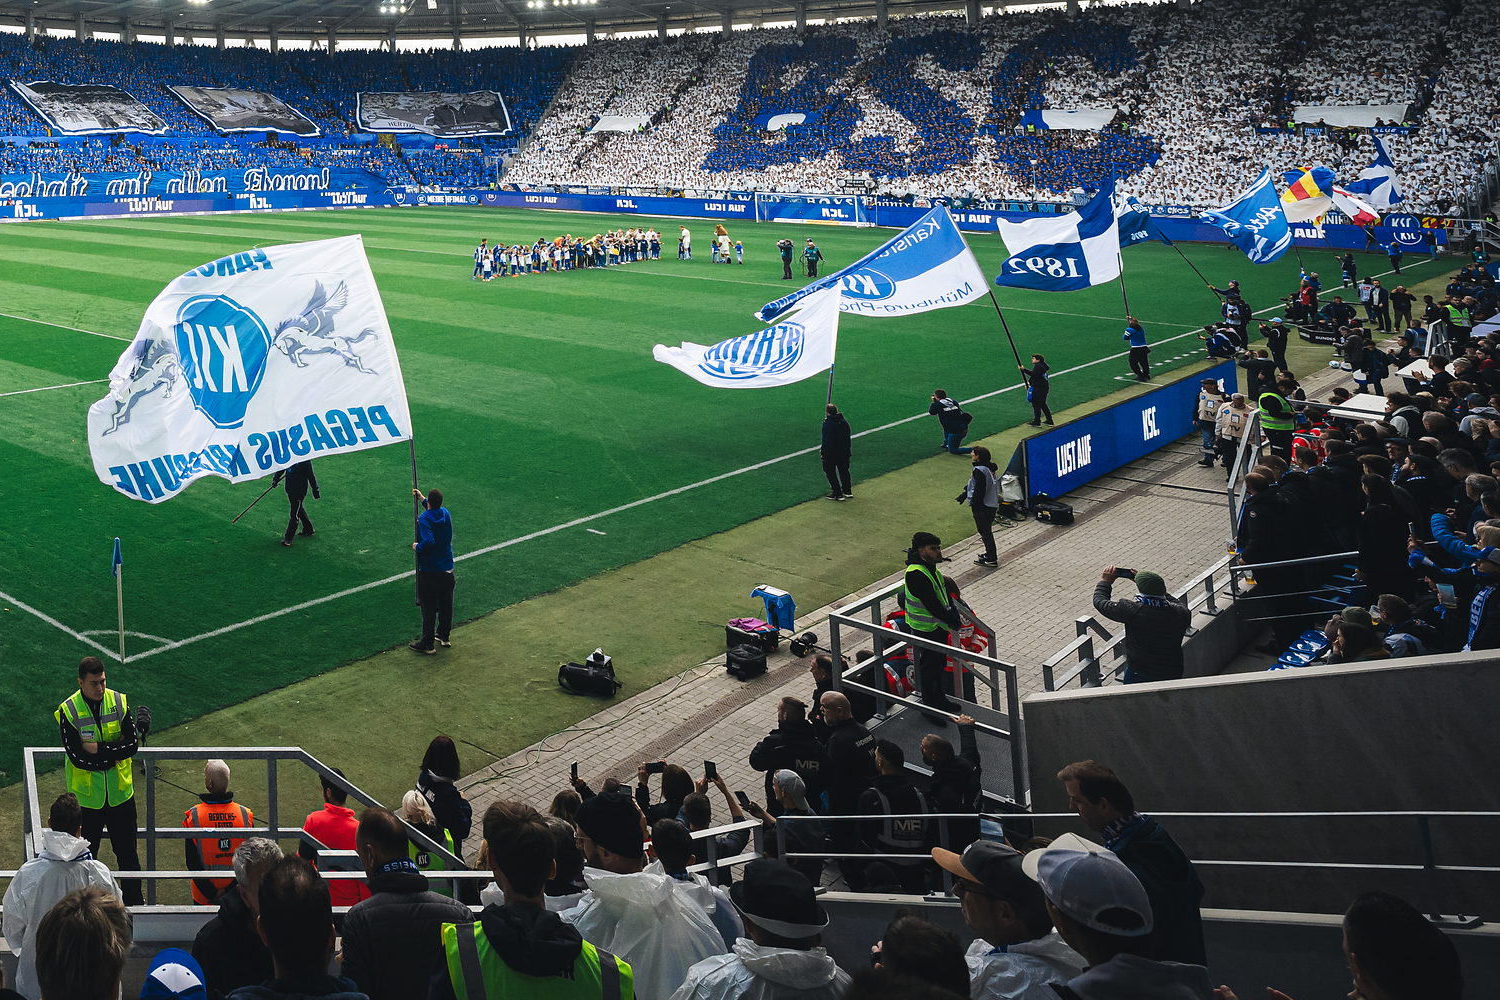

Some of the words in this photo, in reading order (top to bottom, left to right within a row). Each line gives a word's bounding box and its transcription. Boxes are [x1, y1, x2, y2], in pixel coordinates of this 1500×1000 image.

[703, 23, 1162, 192] BSC
[1141, 405, 1160, 441] KSC.
[1229, 424, 1241, 432] TV
[1056, 441, 1077, 478] LUST
[1077, 433, 1092, 469] AUF
[795, 758, 820, 771] MR
[208, 812, 238, 822] BEREICHS-
[893, 819, 922, 831] MR
[220, 838, 230, 850] KSC
[418, 853, 429, 866] KSC
